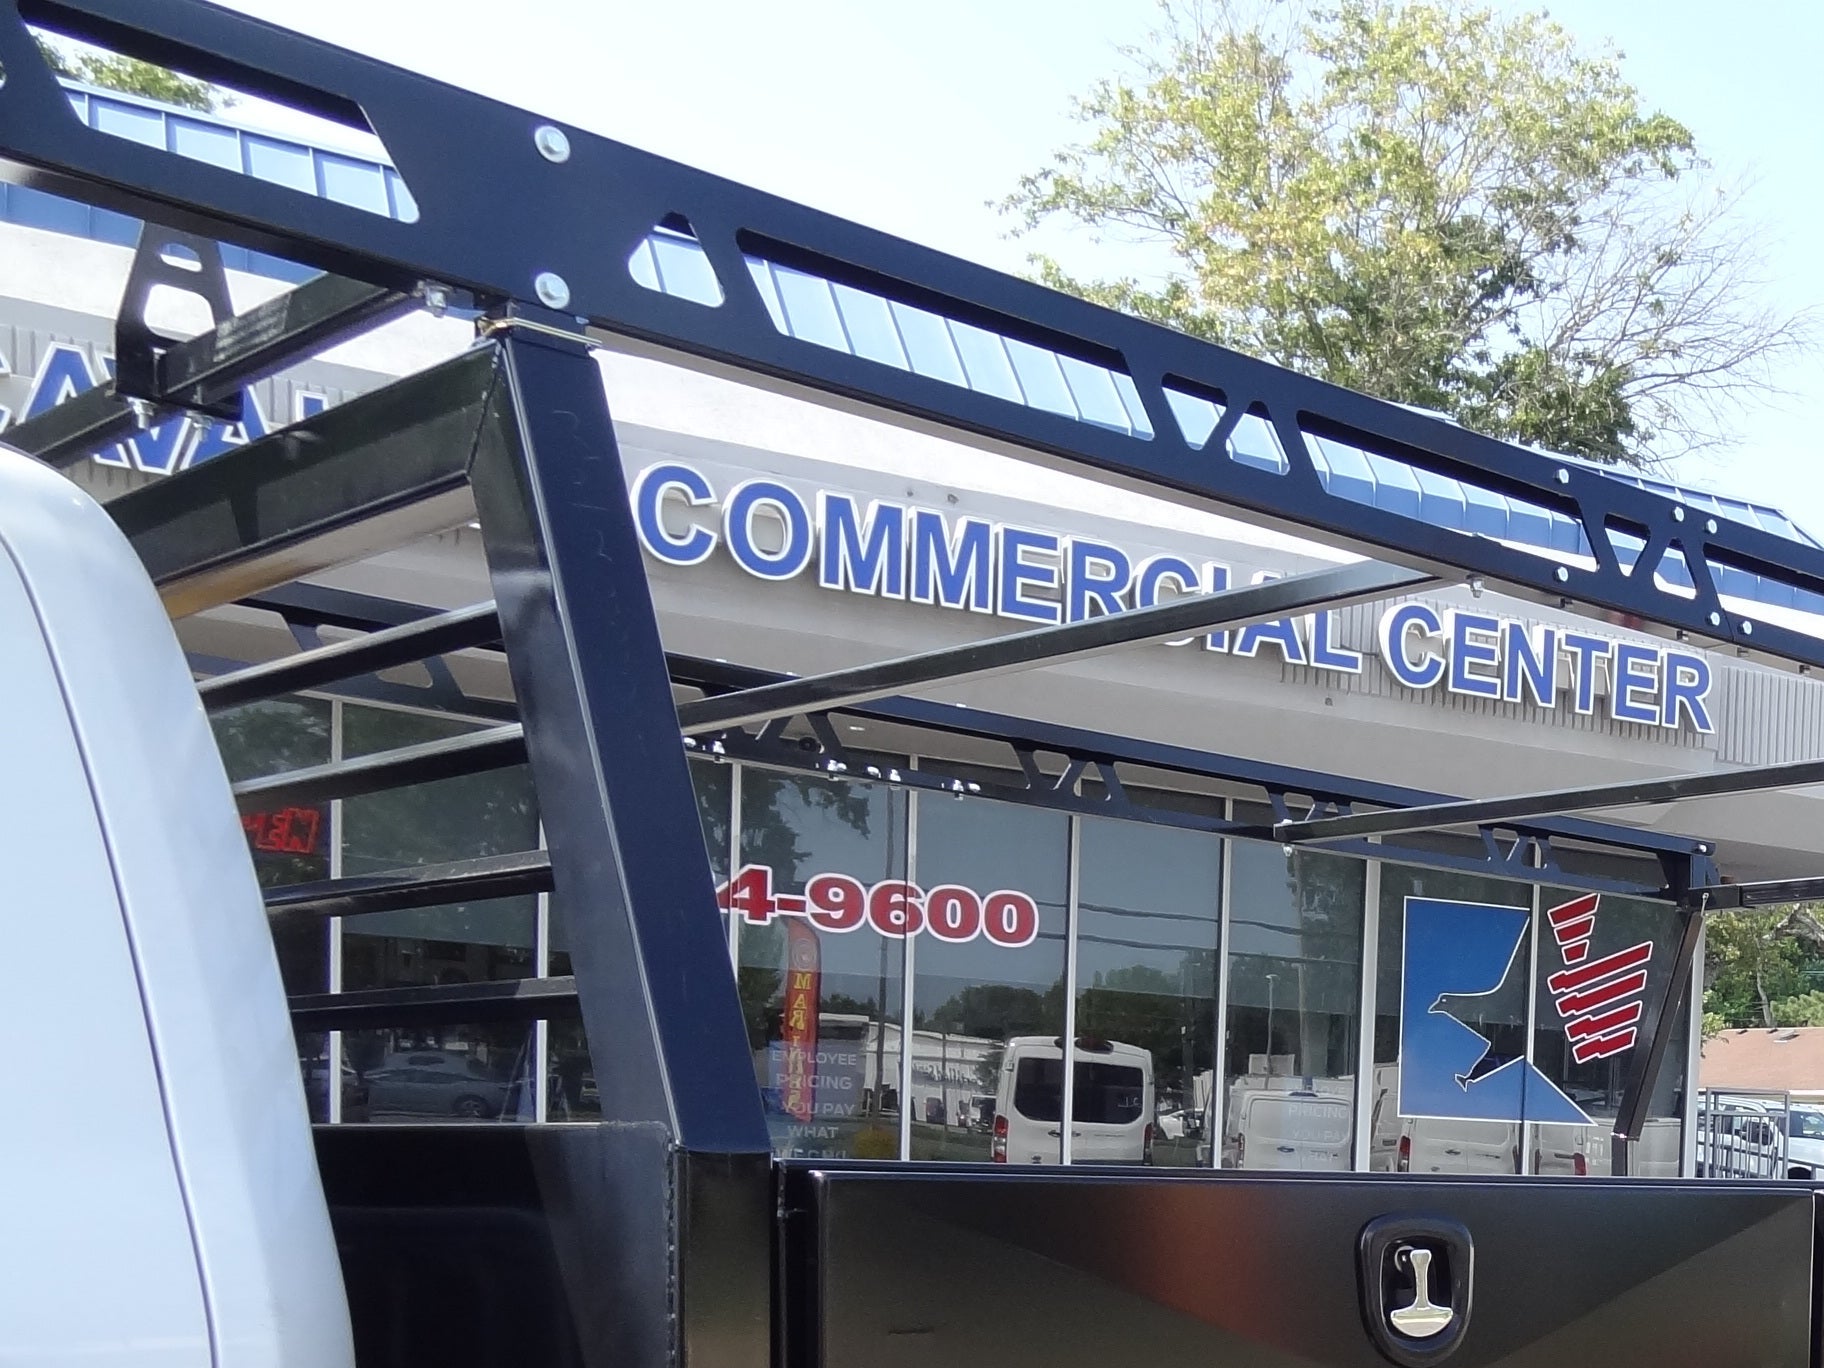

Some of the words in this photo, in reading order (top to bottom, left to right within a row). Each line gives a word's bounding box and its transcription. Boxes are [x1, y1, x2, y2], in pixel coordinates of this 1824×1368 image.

[1378, 601, 1716, 734] CENTER
[771, 1049, 857, 1066] EMPLOYEE
[776, 1073, 853, 1090] PRICING
[822, 1103, 856, 1117] PAY
[788, 1125, 840, 1141] WHAT
